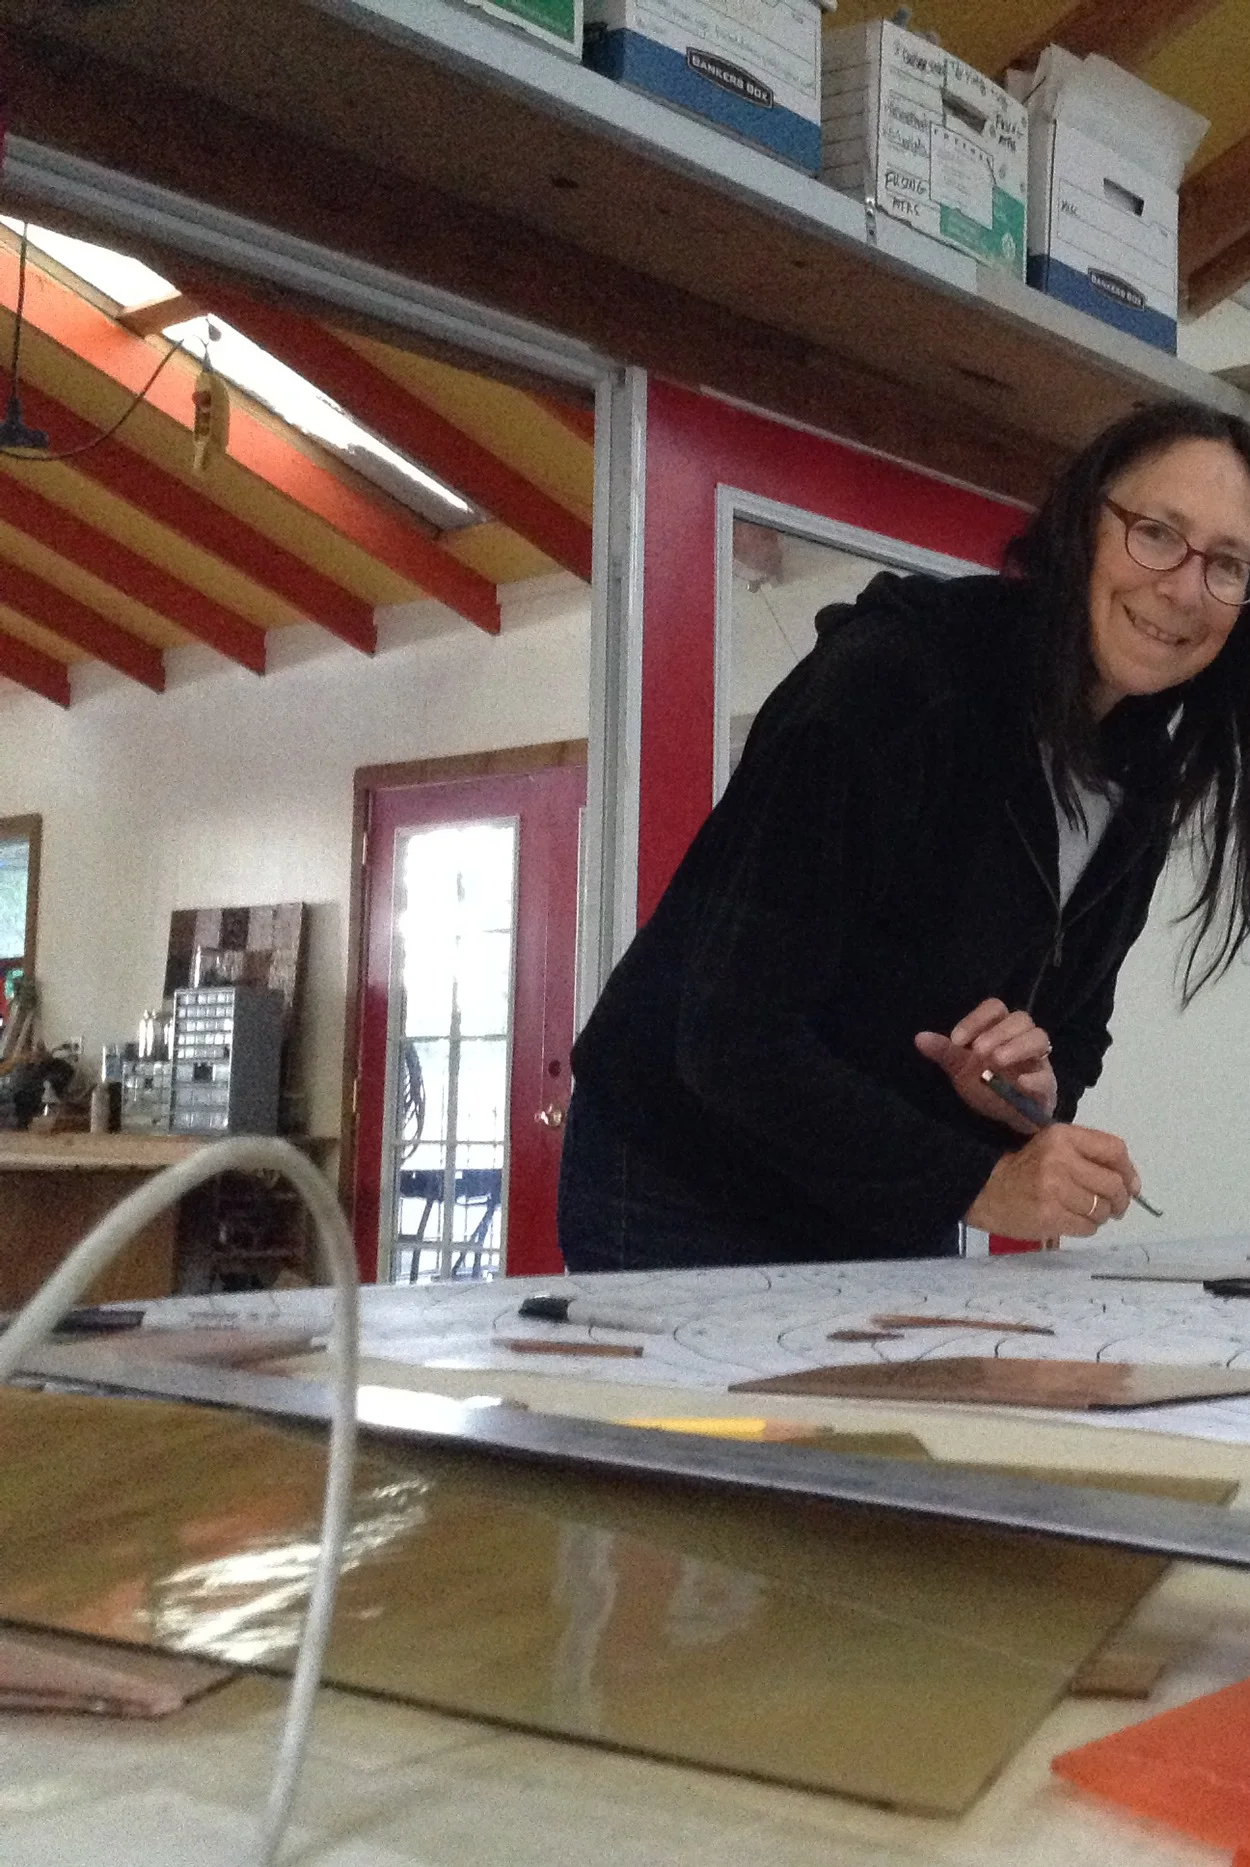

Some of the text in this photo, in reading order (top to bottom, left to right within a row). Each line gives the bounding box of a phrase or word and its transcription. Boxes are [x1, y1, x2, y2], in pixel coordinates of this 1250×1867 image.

[691, 54, 744, 91] BANKERS
[746, 83, 768, 102] BOX
[1091, 274, 1126, 299] BANKERS
